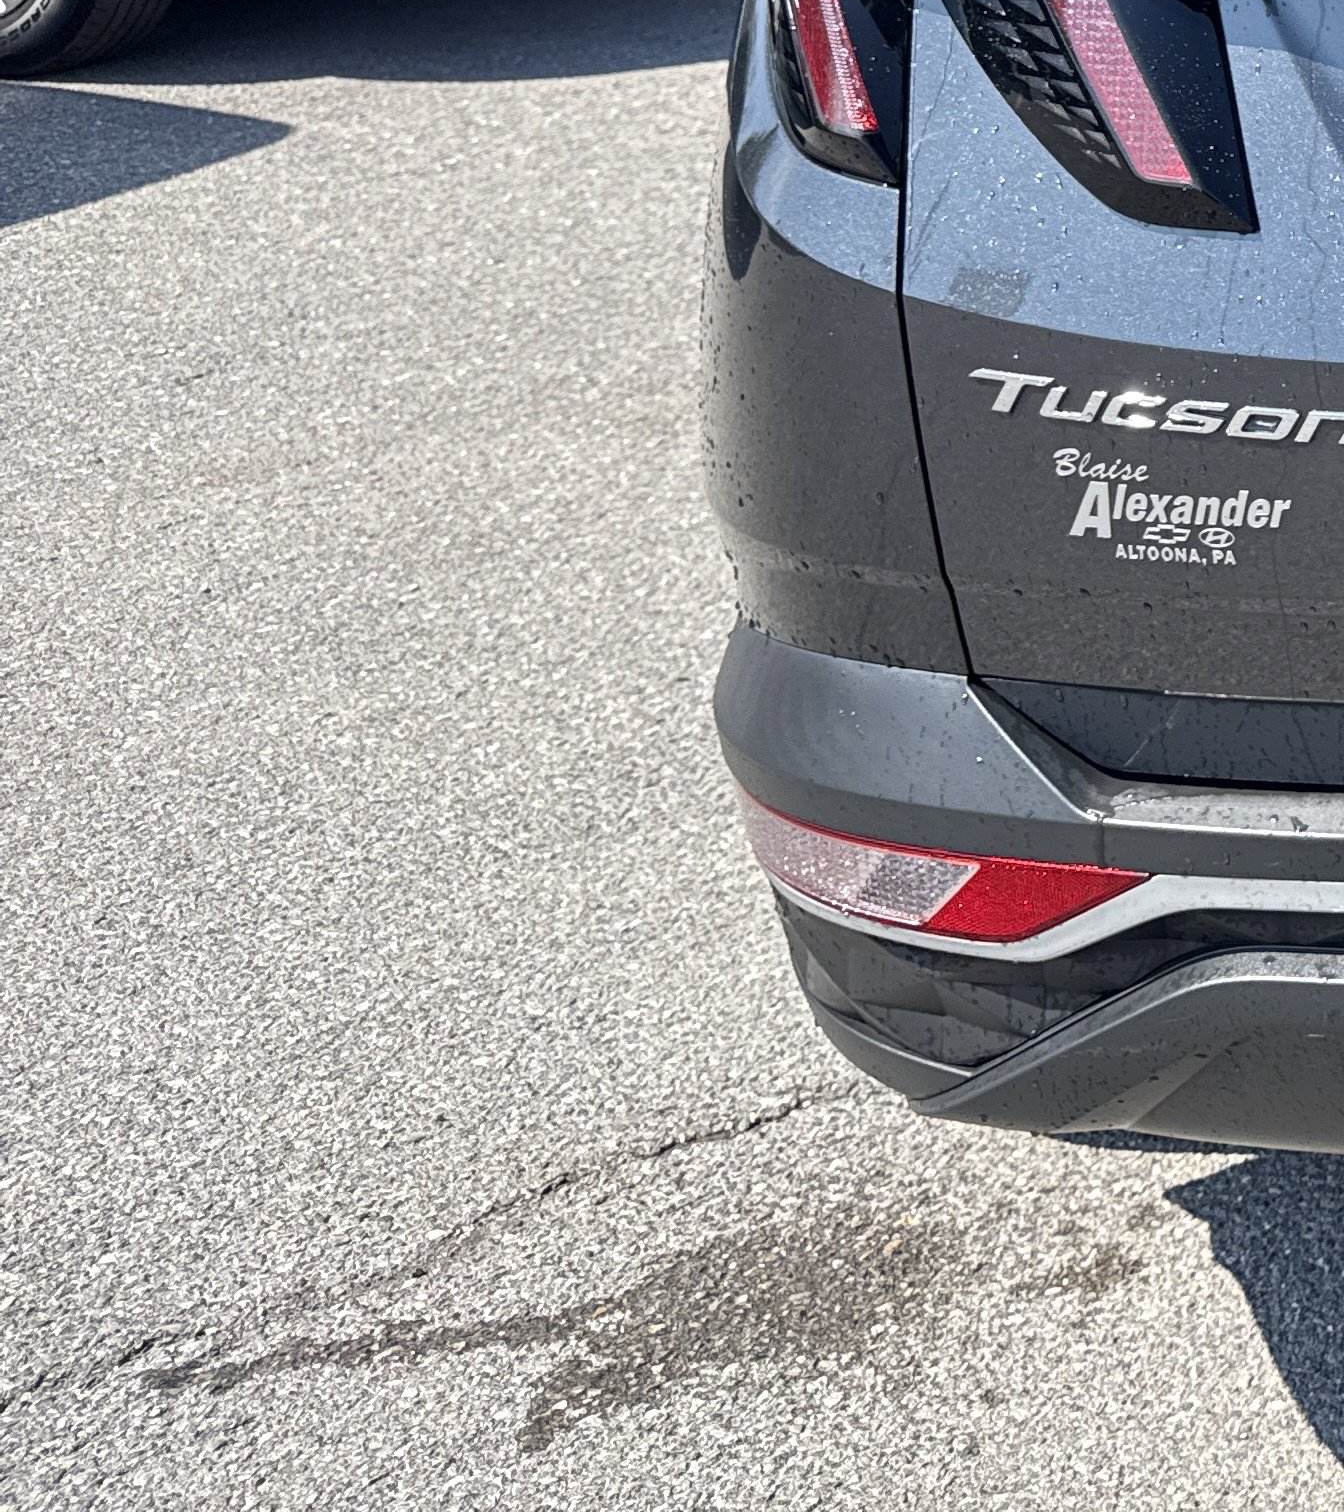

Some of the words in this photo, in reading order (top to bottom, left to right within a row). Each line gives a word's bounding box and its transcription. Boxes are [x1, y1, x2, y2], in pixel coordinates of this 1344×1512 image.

[1052, 447, 1149, 482] Blaise
[1069, 481, 1292, 539] Alexander
[1115, 543, 1207, 567] ALTOONA,
[1212, 549, 1237, 566] PA
